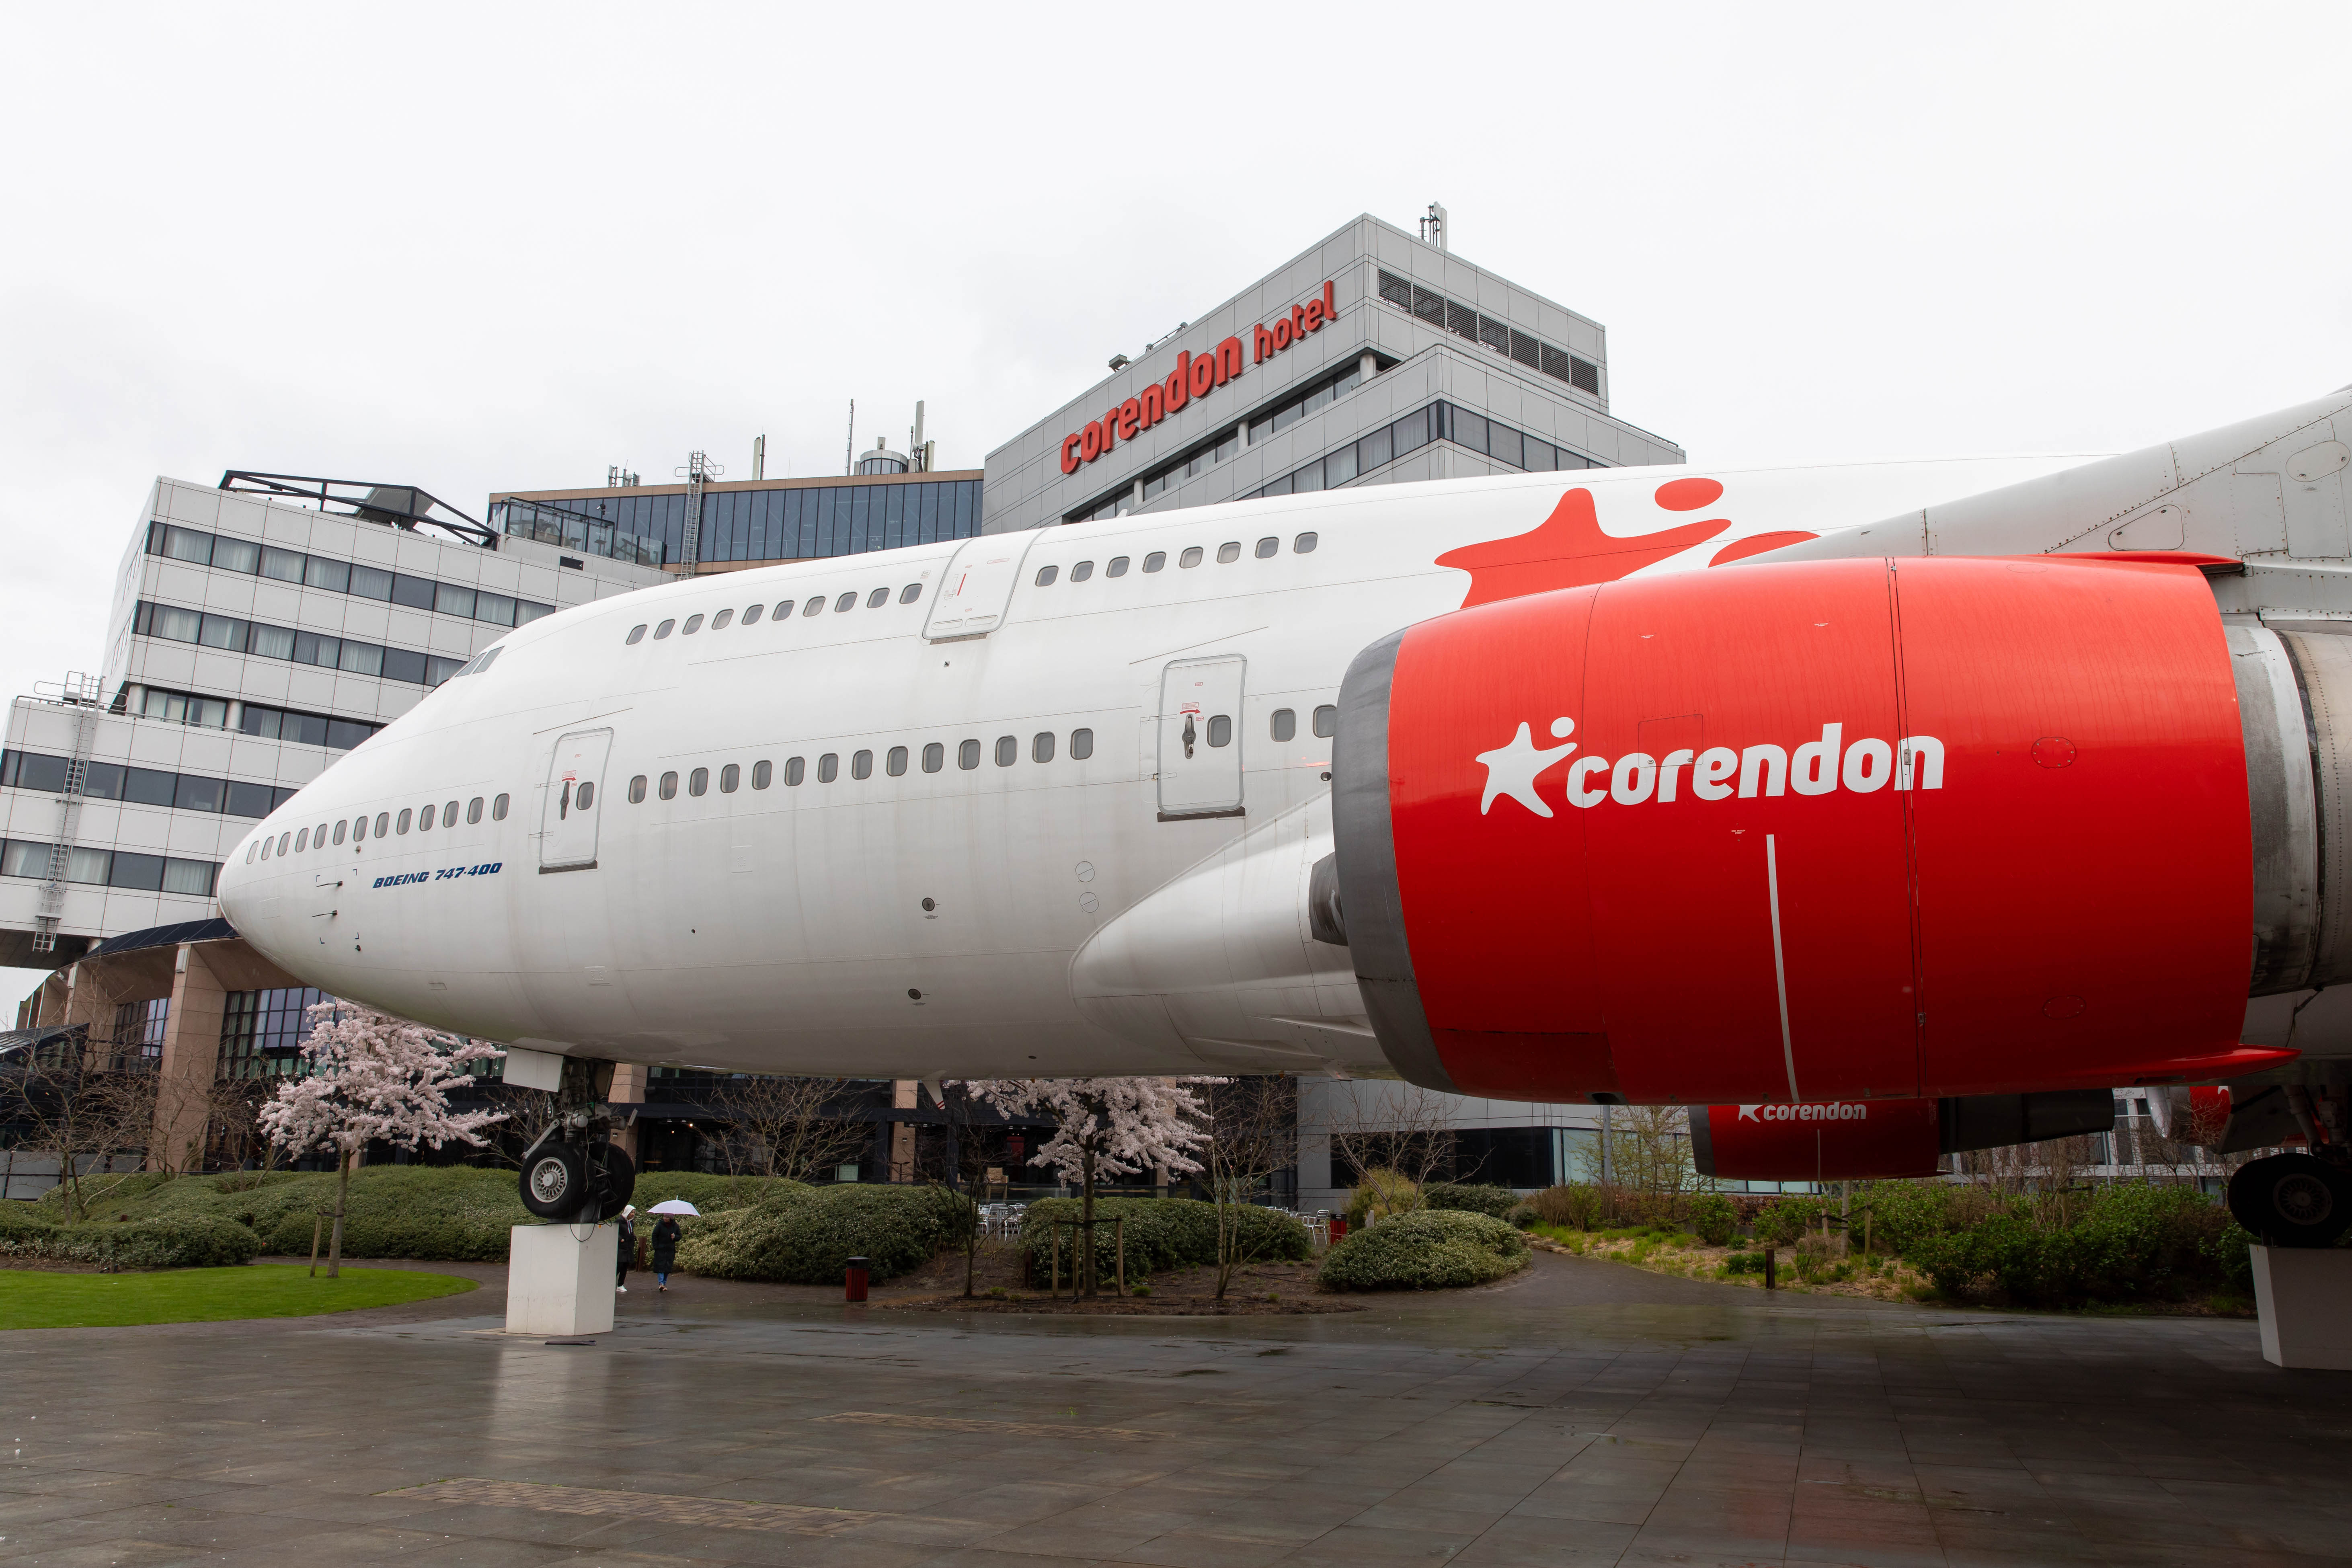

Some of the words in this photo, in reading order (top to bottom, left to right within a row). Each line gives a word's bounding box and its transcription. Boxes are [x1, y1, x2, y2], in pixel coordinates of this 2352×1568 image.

[1061, 336, 1242, 474] corendon
[1254, 280, 1337, 364] hotel
[1566, 722, 1945, 808] corendon
[372, 871, 430, 889] BOEING
[435, 862, 503, 880] 747-400
[1763, 1102, 1867, 1121] corendon
